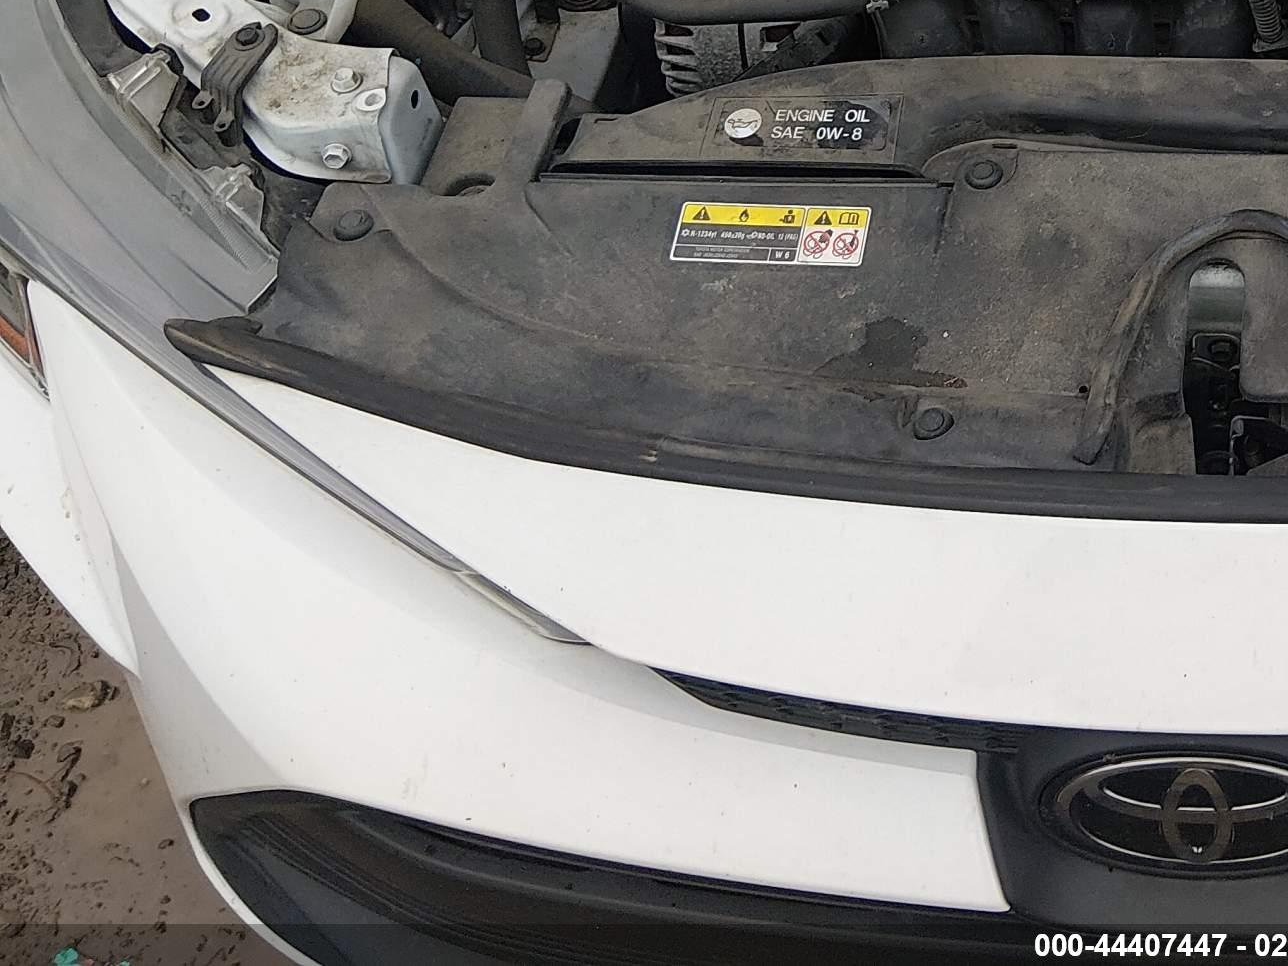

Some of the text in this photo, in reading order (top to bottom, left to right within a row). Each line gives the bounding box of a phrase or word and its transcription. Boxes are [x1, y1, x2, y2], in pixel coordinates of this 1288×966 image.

[774, 109, 871, 123] ENGINE OIL
[770, 126, 862, 141] SAE 0W-8
[774, 251, 783, 259] W
